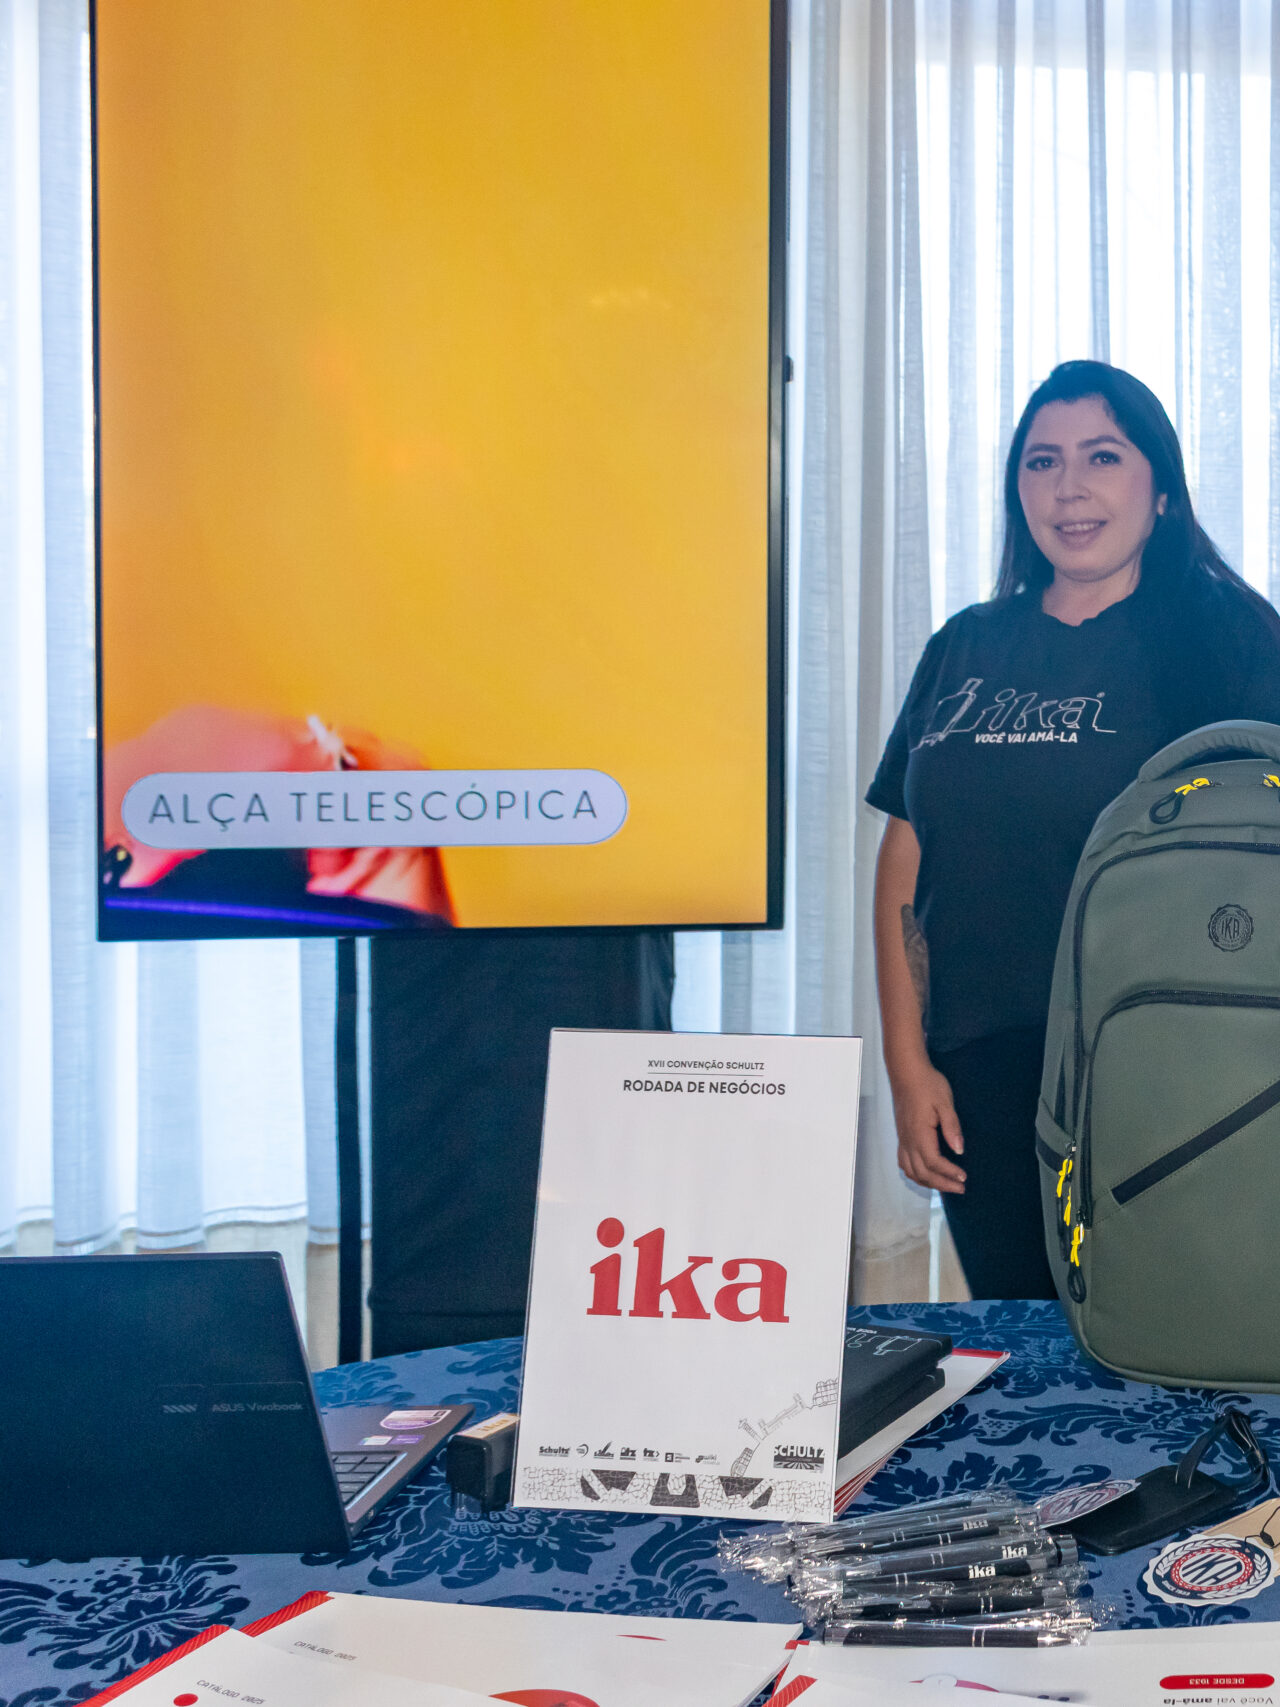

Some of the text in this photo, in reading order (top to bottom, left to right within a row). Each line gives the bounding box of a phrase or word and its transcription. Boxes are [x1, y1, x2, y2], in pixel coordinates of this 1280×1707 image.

[975, 729, 1078, 743] VOCÊ VAI AMÁ-LA
[148, 783, 598, 832] ALÇA TELESCÓPICA
[648, 1060, 765, 1071] XVII CONVENÇÃO SCHULTZ
[623, 1079, 786, 1096] RODADA DE NEGÓCIOS
[586, 1217, 790, 1324] ika
[212, 1402, 303, 1413] ASUS Vivobook
[774, 1444, 825, 1459] SCHULTZ
[1002, 1544, 1028, 1560] ika
[968, 1563, 996, 1580] ika
[1213, 1677, 1245, 1685] DESDE
[1163, 1696, 1274, 1706] Você vai amá-la
